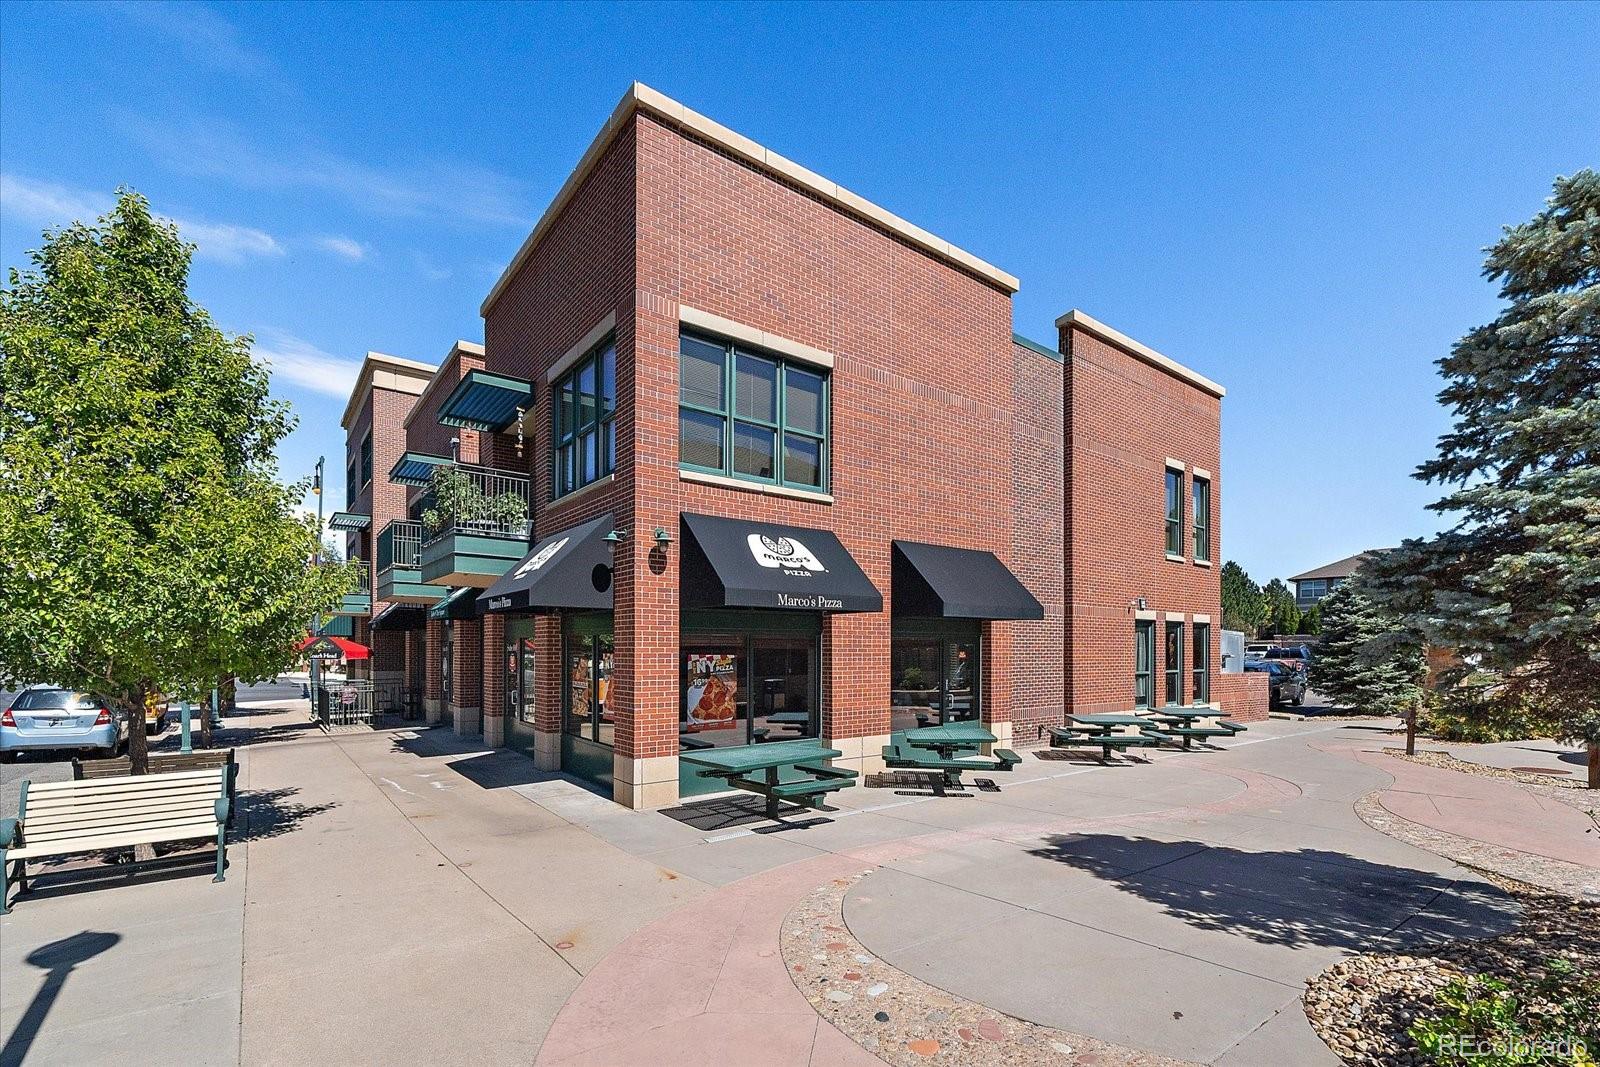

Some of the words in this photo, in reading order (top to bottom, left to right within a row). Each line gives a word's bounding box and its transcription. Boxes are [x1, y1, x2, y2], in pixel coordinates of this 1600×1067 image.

[783, 569, 812, 577] PIZZA
[777, 593, 817, 607] Marco's
[818, 595, 843, 609] Pizza
[696, 657, 716, 673] NY
